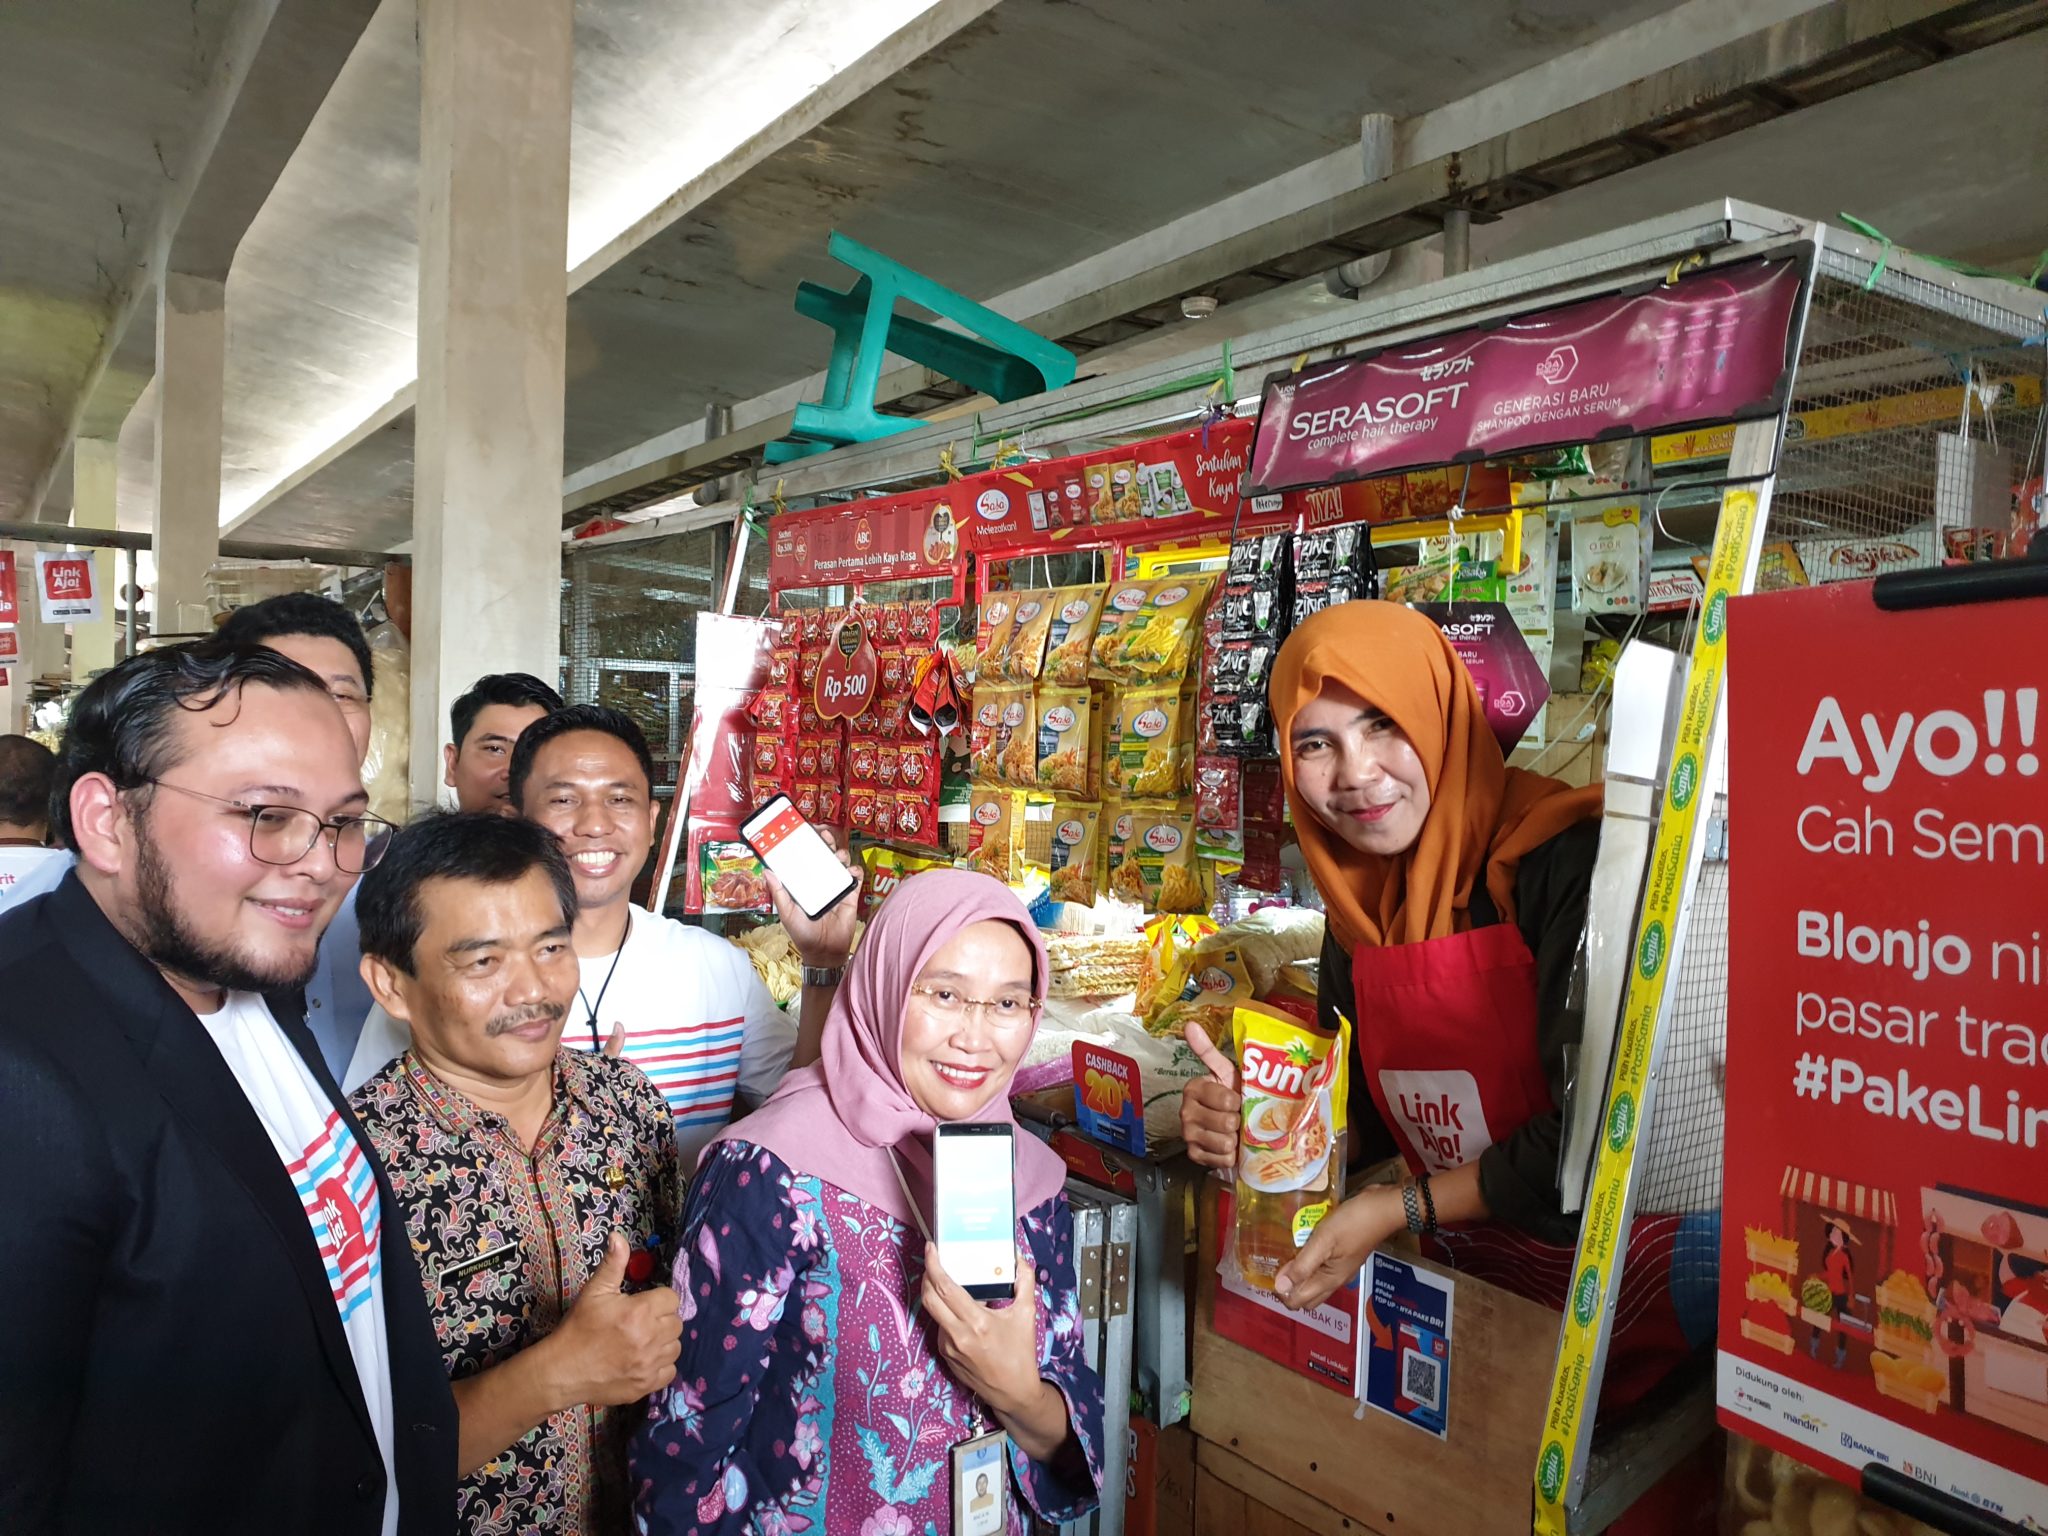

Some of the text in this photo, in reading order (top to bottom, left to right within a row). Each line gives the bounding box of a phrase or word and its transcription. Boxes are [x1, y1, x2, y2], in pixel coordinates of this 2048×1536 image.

[1420, 356, 1475, 381] セラソフト
[1493, 383, 1609, 415] GENERASI BARU
[1289, 382, 1469, 441] SERASOFT
[1477, 398, 1621, 433] SHAMPOO DENGAN SERUM
[1308, 416, 1438, 450] complete hair therapy
[1196, 450, 1242, 478] Sentuhan
[1209, 474, 1234, 504] Kaya
[980, 494, 1007, 515] Sasa
[856, 531, 870, 544] ABC
[1301, 538, 1331, 554] ZINC
[814, 550, 916, 570] Perasan Pertama Lebih Kaya Rasa
[52, 567, 81, 578] Link
[54, 577, 79, 590] Aja!
[1117, 592, 1143, 607] Sasa
[1159, 590, 1185, 603] Sasa
[912, 617, 926, 626] ABC
[1064, 605, 1085, 620] Sasa
[1707, 600, 1724, 636] Sania
[1441, 624, 1494, 635] ASOFT
[1459, 634, 1482, 642] therapy
[824, 674, 867, 703] Rp 500
[1047, 710, 1074, 726] Sasa
[1138, 713, 1164, 731] Sasa
[1796, 688, 2040, 793] Ayo!!
[760, 753, 773, 762] ABC
[856, 759, 871, 769] ABC
[905, 764, 921, 775] ABC
[1675, 763, 1692, 801] Sania
[800, 800, 813, 810] ABC
[854, 807, 870, 816] ABC
[978, 806, 999, 821] Sasa
[878, 812, 890, 822] ABC
[1061, 821, 1082, 840] Sasa
[1148, 826, 1176, 845] Sasa
[1797, 804, 2045, 865] Cah Sem
[1643, 932, 1660, 969] Sania
[1797, 909, 2048, 986] Blonjo ni
[1796, 991, 1939, 1048] pasar
[1085, 1052, 1129, 1079] CASHBACK
[1085, 1068, 1132, 1120] 20%
[1398, 1092, 1465, 1131] Link
[1612, 1103, 1629, 1142] Sania
[1417, 1126, 1464, 1164] Aja!
[458, 1255, 500, 1278] NURKHOLIS
[1375, 1278, 1395, 1292] BAYAR
[1578, 1277, 1596, 1317] Sania
[1375, 1294, 1387, 1304] TOP
[1387, 1300, 1396, 1308] UP
[1400, 1306, 1412, 1316] NYA
[1429, 1316, 1444, 1329] BRI
[1735, 1365, 1779, 1393] Didukung
[1783, 1410, 1819, 1434] mandiri
[1853, 1440, 1875, 1457] BANK
[1542, 1451, 1559, 1489] Sania
[1915, 1466, 1937, 1486] BNI
[1982, 1498, 2004, 1513] BTN
